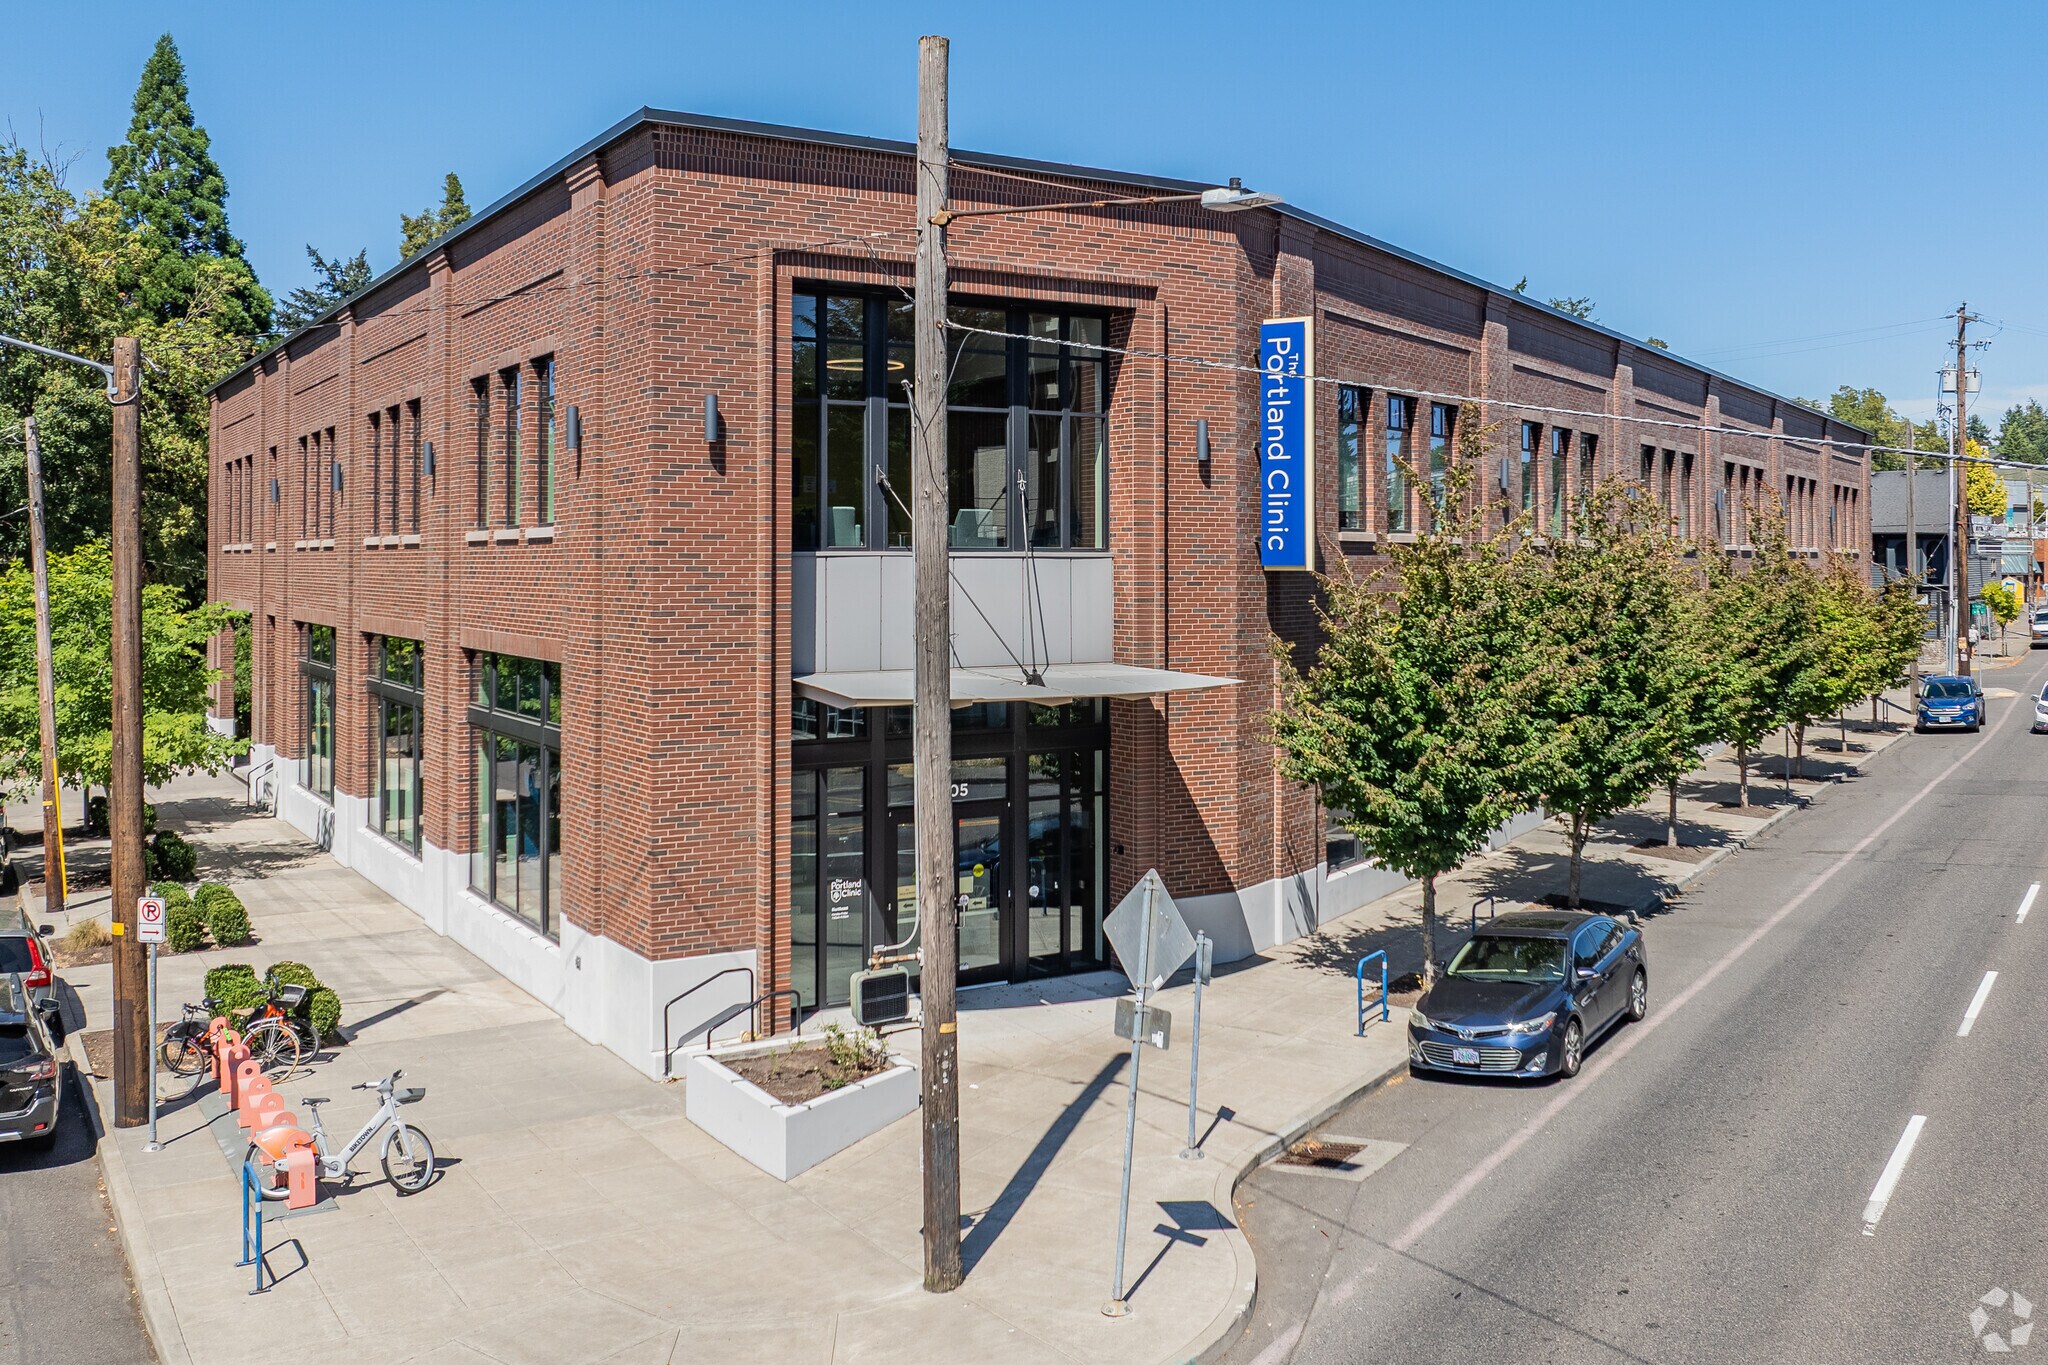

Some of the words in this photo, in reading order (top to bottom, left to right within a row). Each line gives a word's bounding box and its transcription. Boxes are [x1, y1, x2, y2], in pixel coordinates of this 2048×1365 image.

[1289, 353, 1298, 377] The
[1267, 337, 1291, 460] Portland
[1268, 469, 1292, 551] Clinic
[831, 879, 862, 889] Portland
[842, 889, 862, 897] Clinic
[349, 1126, 374, 1152] BIKETOWN
